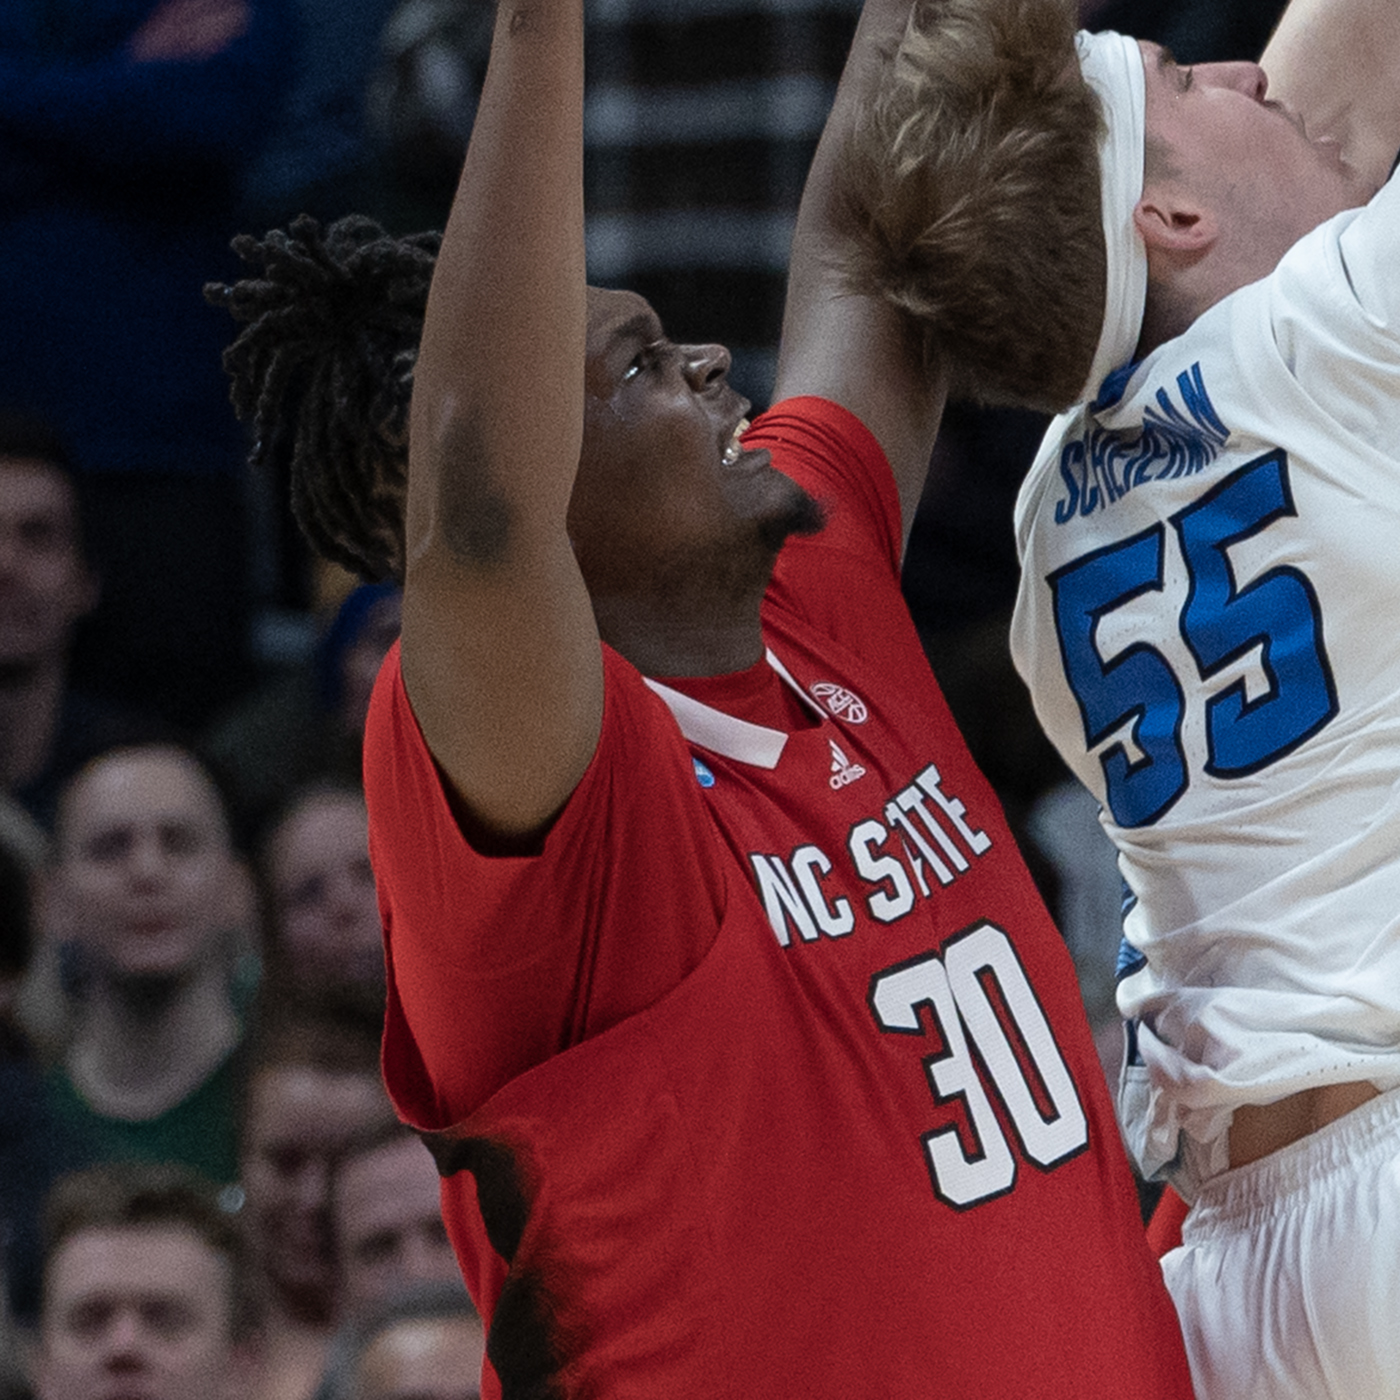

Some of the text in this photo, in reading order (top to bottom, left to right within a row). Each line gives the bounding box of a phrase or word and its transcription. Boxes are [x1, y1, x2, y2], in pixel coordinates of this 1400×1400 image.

[1045, 446, 1340, 829] 55
[748, 762, 993, 949] NC STATE
[867, 917, 1090, 1212] 30
